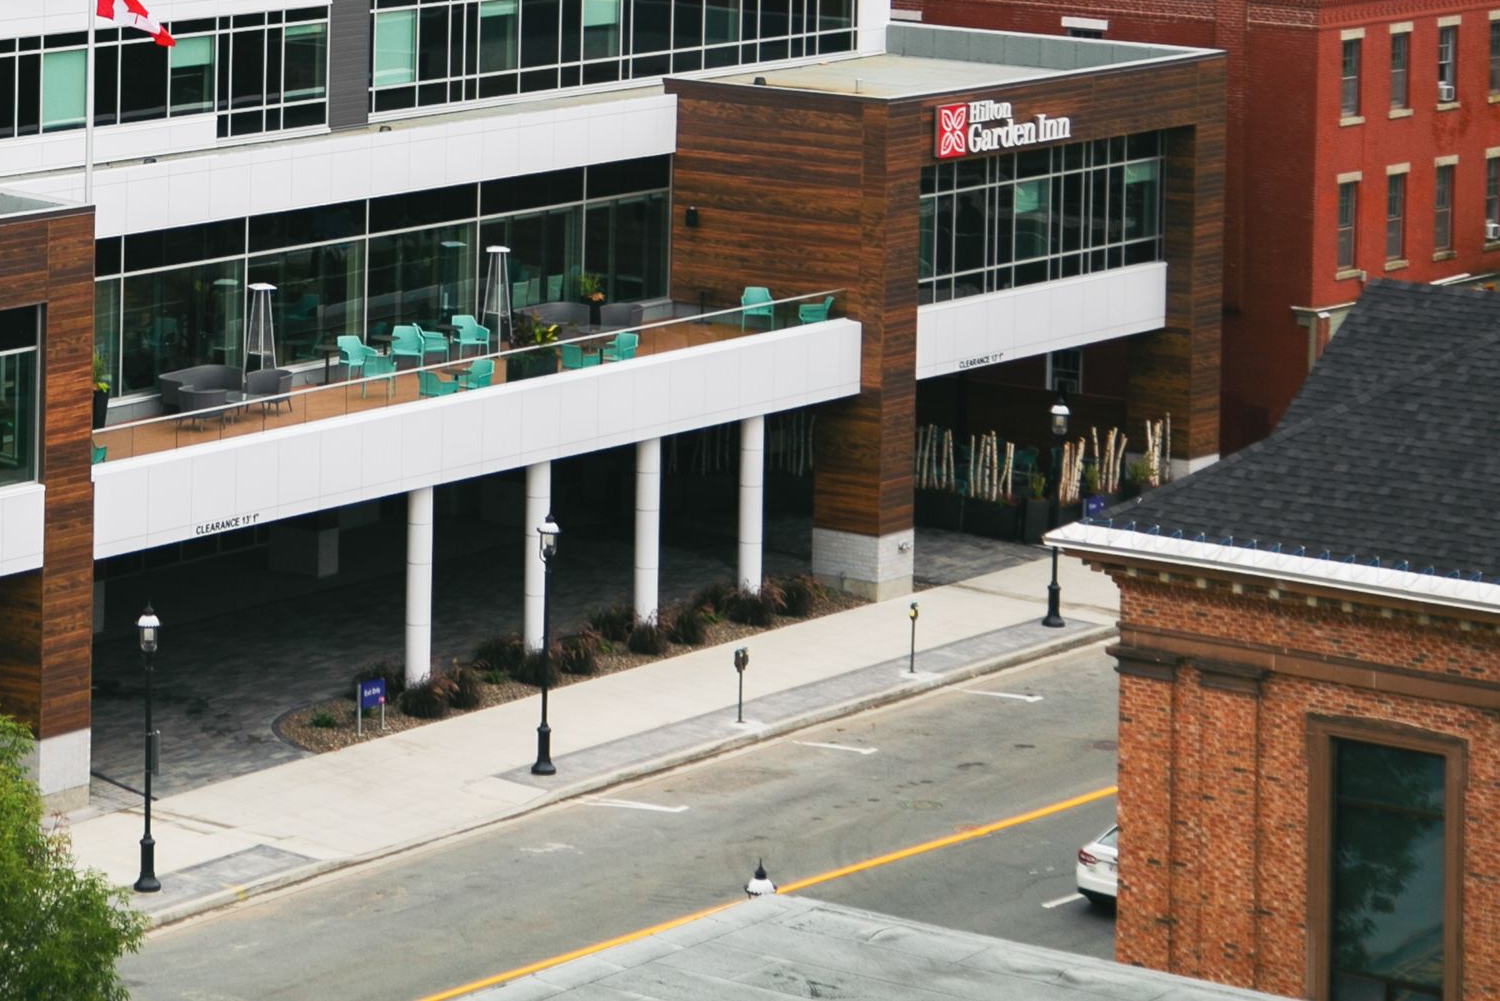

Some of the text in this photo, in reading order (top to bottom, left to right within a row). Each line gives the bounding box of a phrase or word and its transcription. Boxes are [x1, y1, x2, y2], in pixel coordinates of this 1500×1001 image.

[968, 99, 1012, 124] Hilton
[967, 113, 1071, 153] Garden Inn
[195, 516, 241, 535] CLEARANCE
